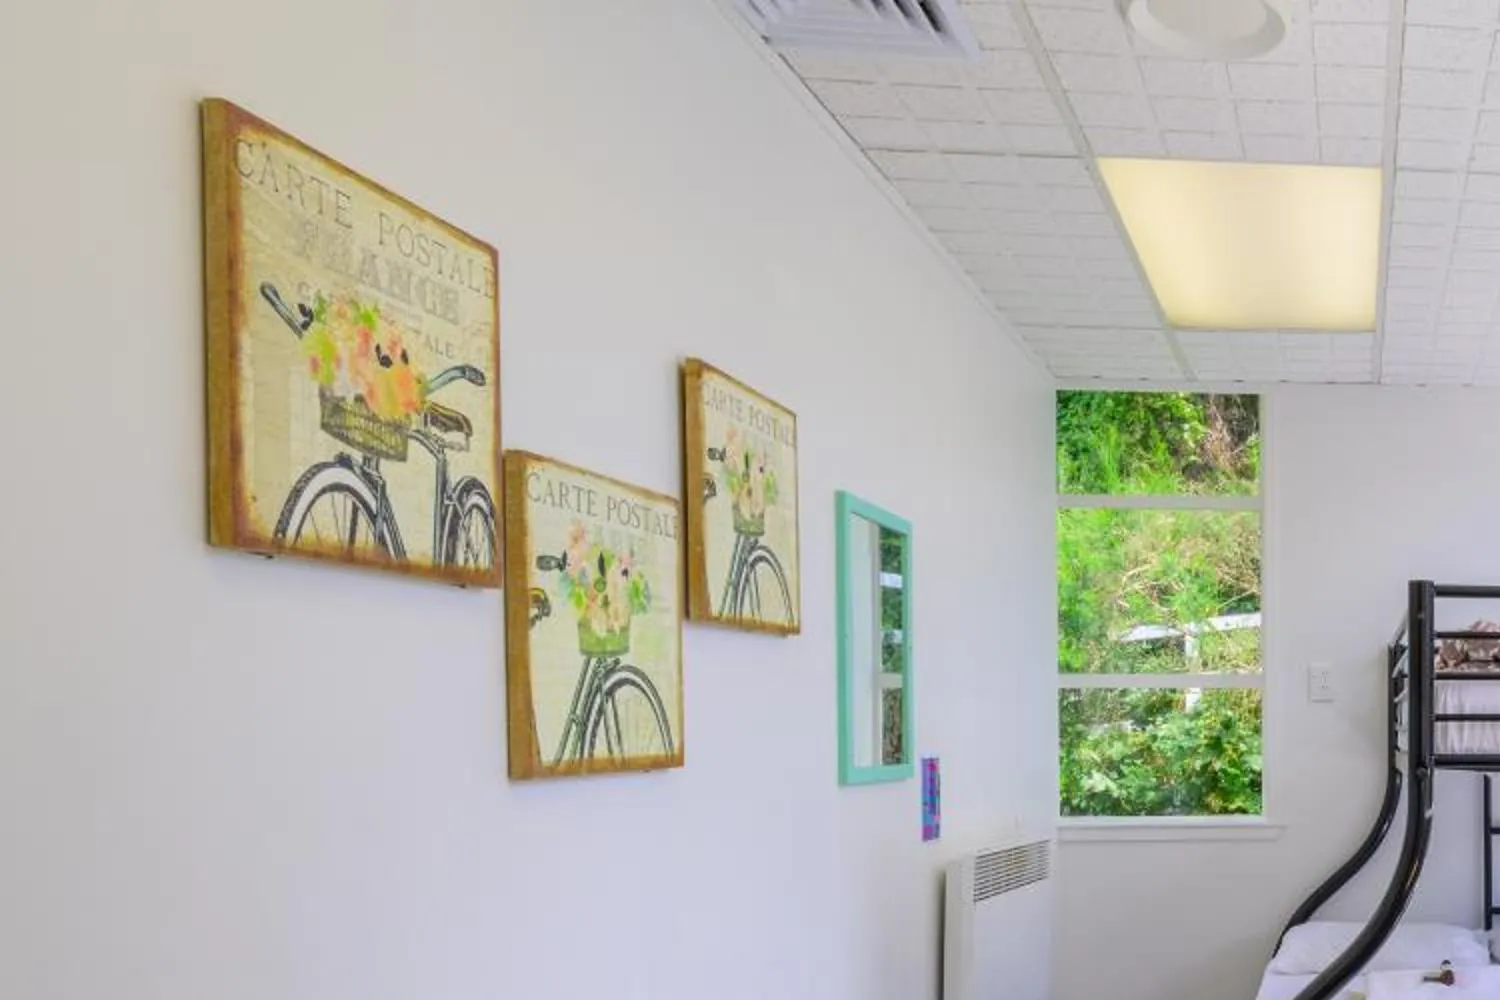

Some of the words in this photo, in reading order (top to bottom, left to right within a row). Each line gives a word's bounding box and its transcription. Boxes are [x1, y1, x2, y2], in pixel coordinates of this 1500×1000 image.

[234, 138, 353, 229] CARTE
[377, 212, 495, 299] POSTALE
[525, 471, 599, 517] CARTE
